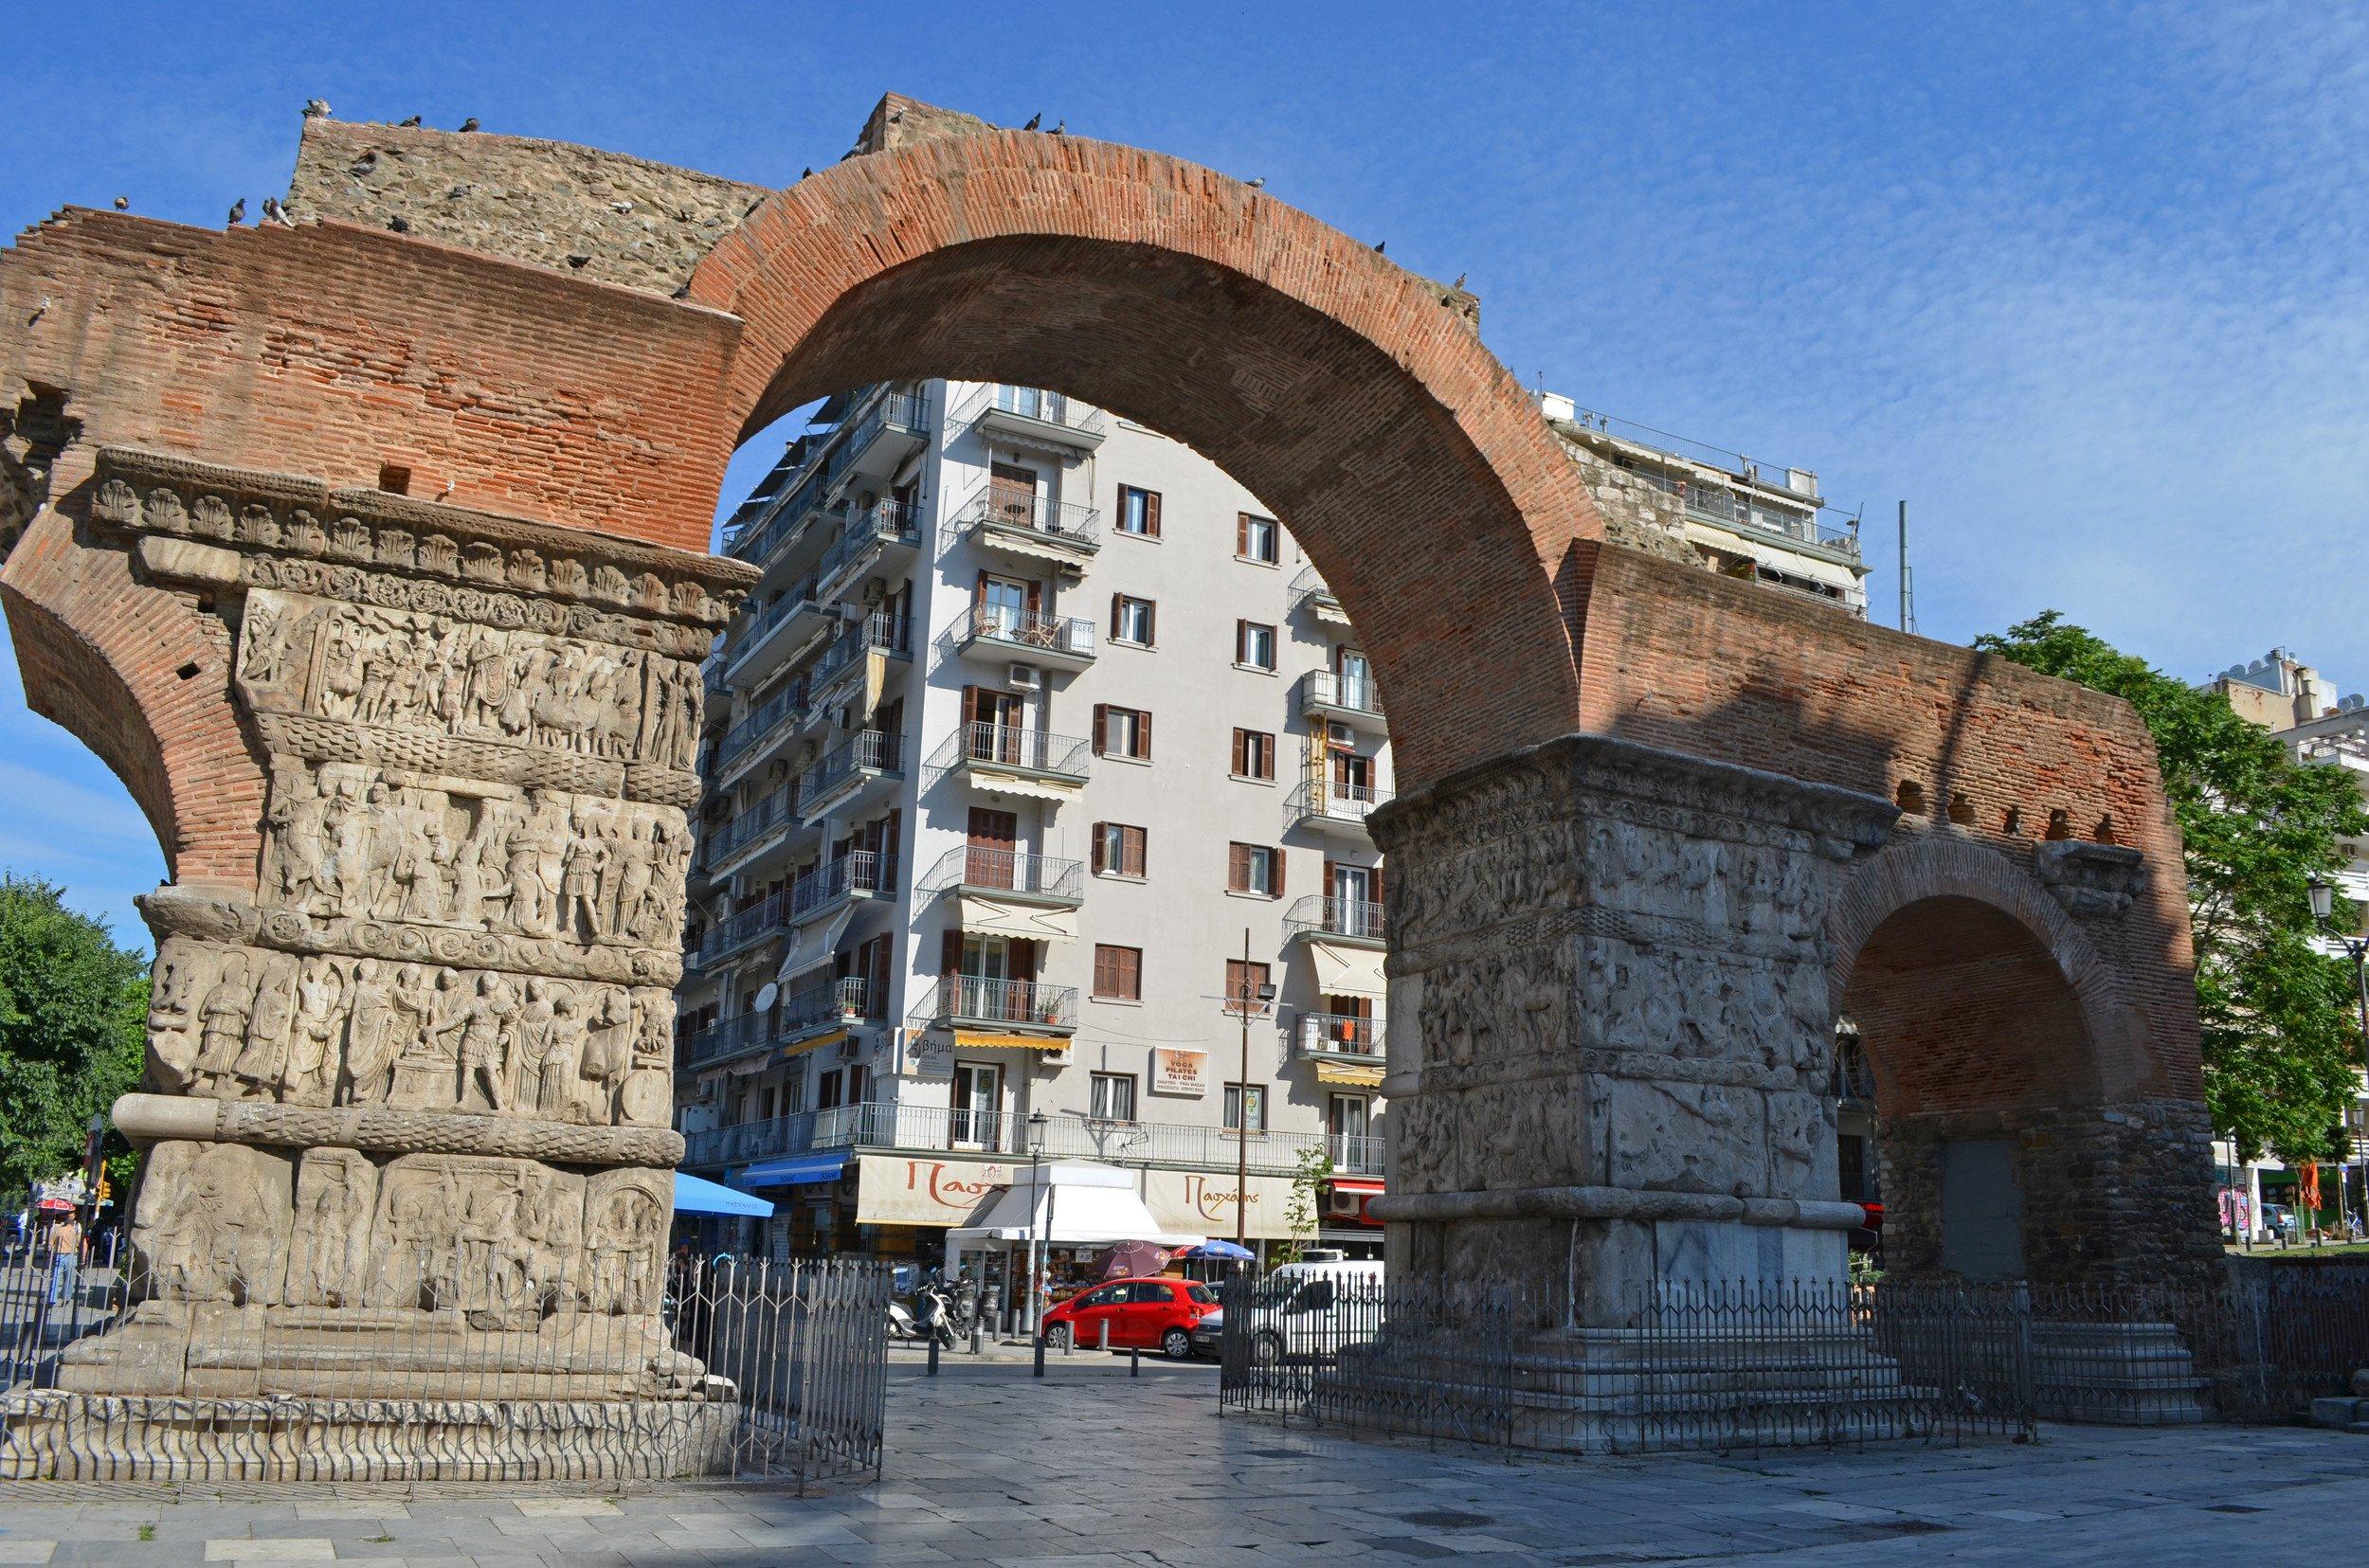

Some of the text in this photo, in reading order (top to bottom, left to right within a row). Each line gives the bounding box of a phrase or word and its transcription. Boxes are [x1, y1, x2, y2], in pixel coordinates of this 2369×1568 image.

[922, 1039, 952, 1054] βήμα
[908, 1162, 1008, 1209] Πασχ
[1184, 1176, 1259, 1221] Πασχάης
